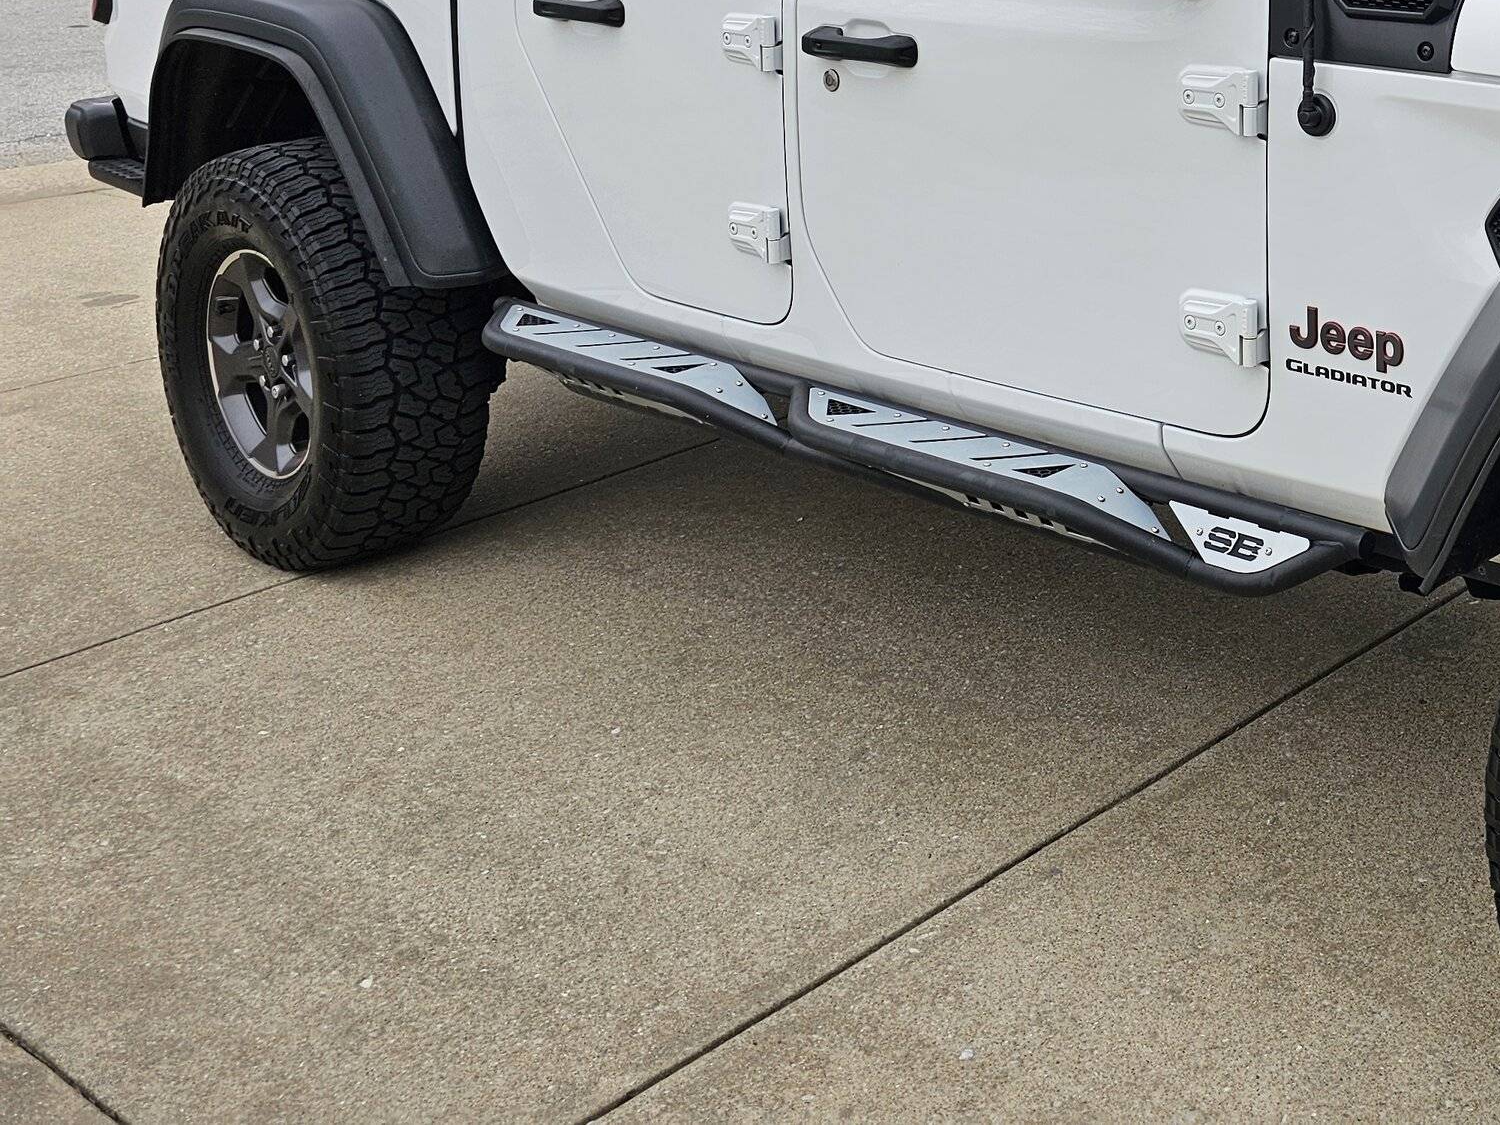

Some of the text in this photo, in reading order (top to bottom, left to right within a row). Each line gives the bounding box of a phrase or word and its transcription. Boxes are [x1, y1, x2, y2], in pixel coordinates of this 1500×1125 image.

[1289, 306, 1404, 373] Jeep
[1286, 358, 1413, 398] GLADIATOR
[1203, 526, 1265, 562] SB
